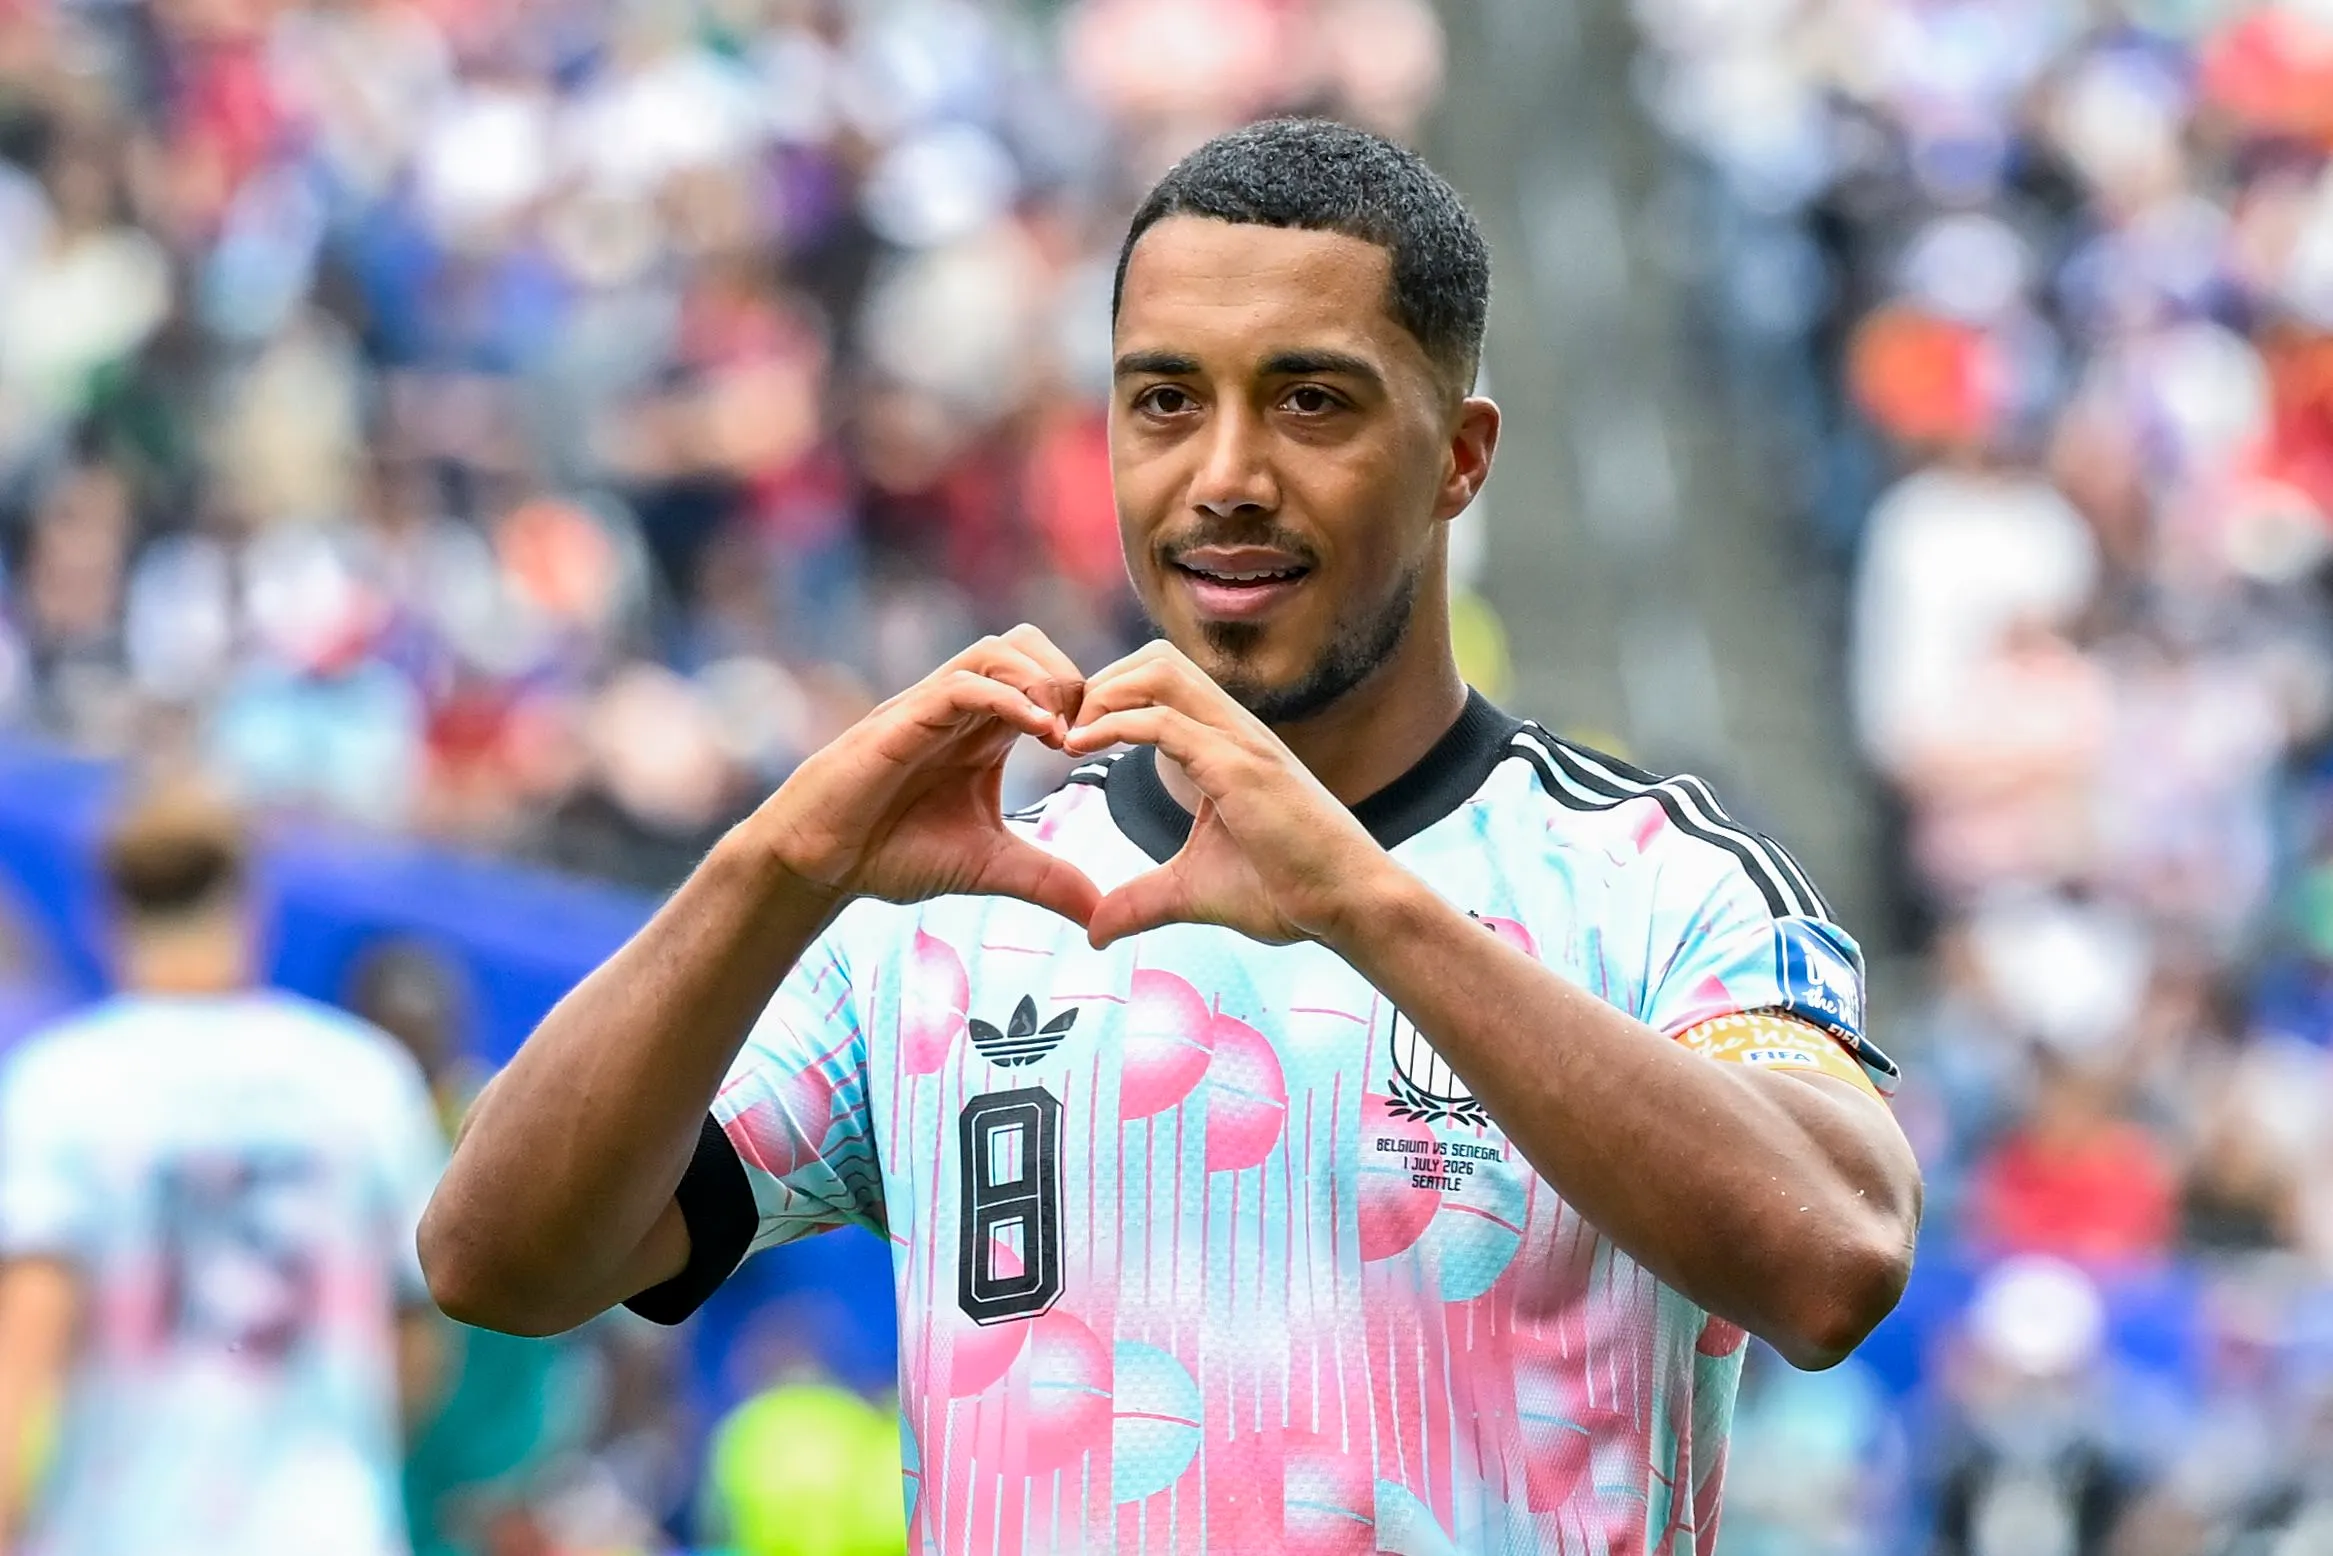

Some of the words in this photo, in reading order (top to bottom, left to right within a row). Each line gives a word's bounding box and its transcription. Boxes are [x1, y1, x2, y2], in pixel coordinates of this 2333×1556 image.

[1827, 1022, 1860, 1051] FIFA
[1749, 1051, 1811, 1062] FIFA
[1376, 1138, 1429, 1154] BELGIUM
[1433, 1142, 1448, 1155] VS
[1451, 1143, 1503, 1162] SENEGAL
[1403, 1156, 1408, 1169] 1
[1411, 1156, 1440, 1172] JULY
[1442, 1160, 1474, 1175] 2026
[1411, 1174, 1462, 1191] SEATTLE
[958, 1086, 1065, 1326] 8
